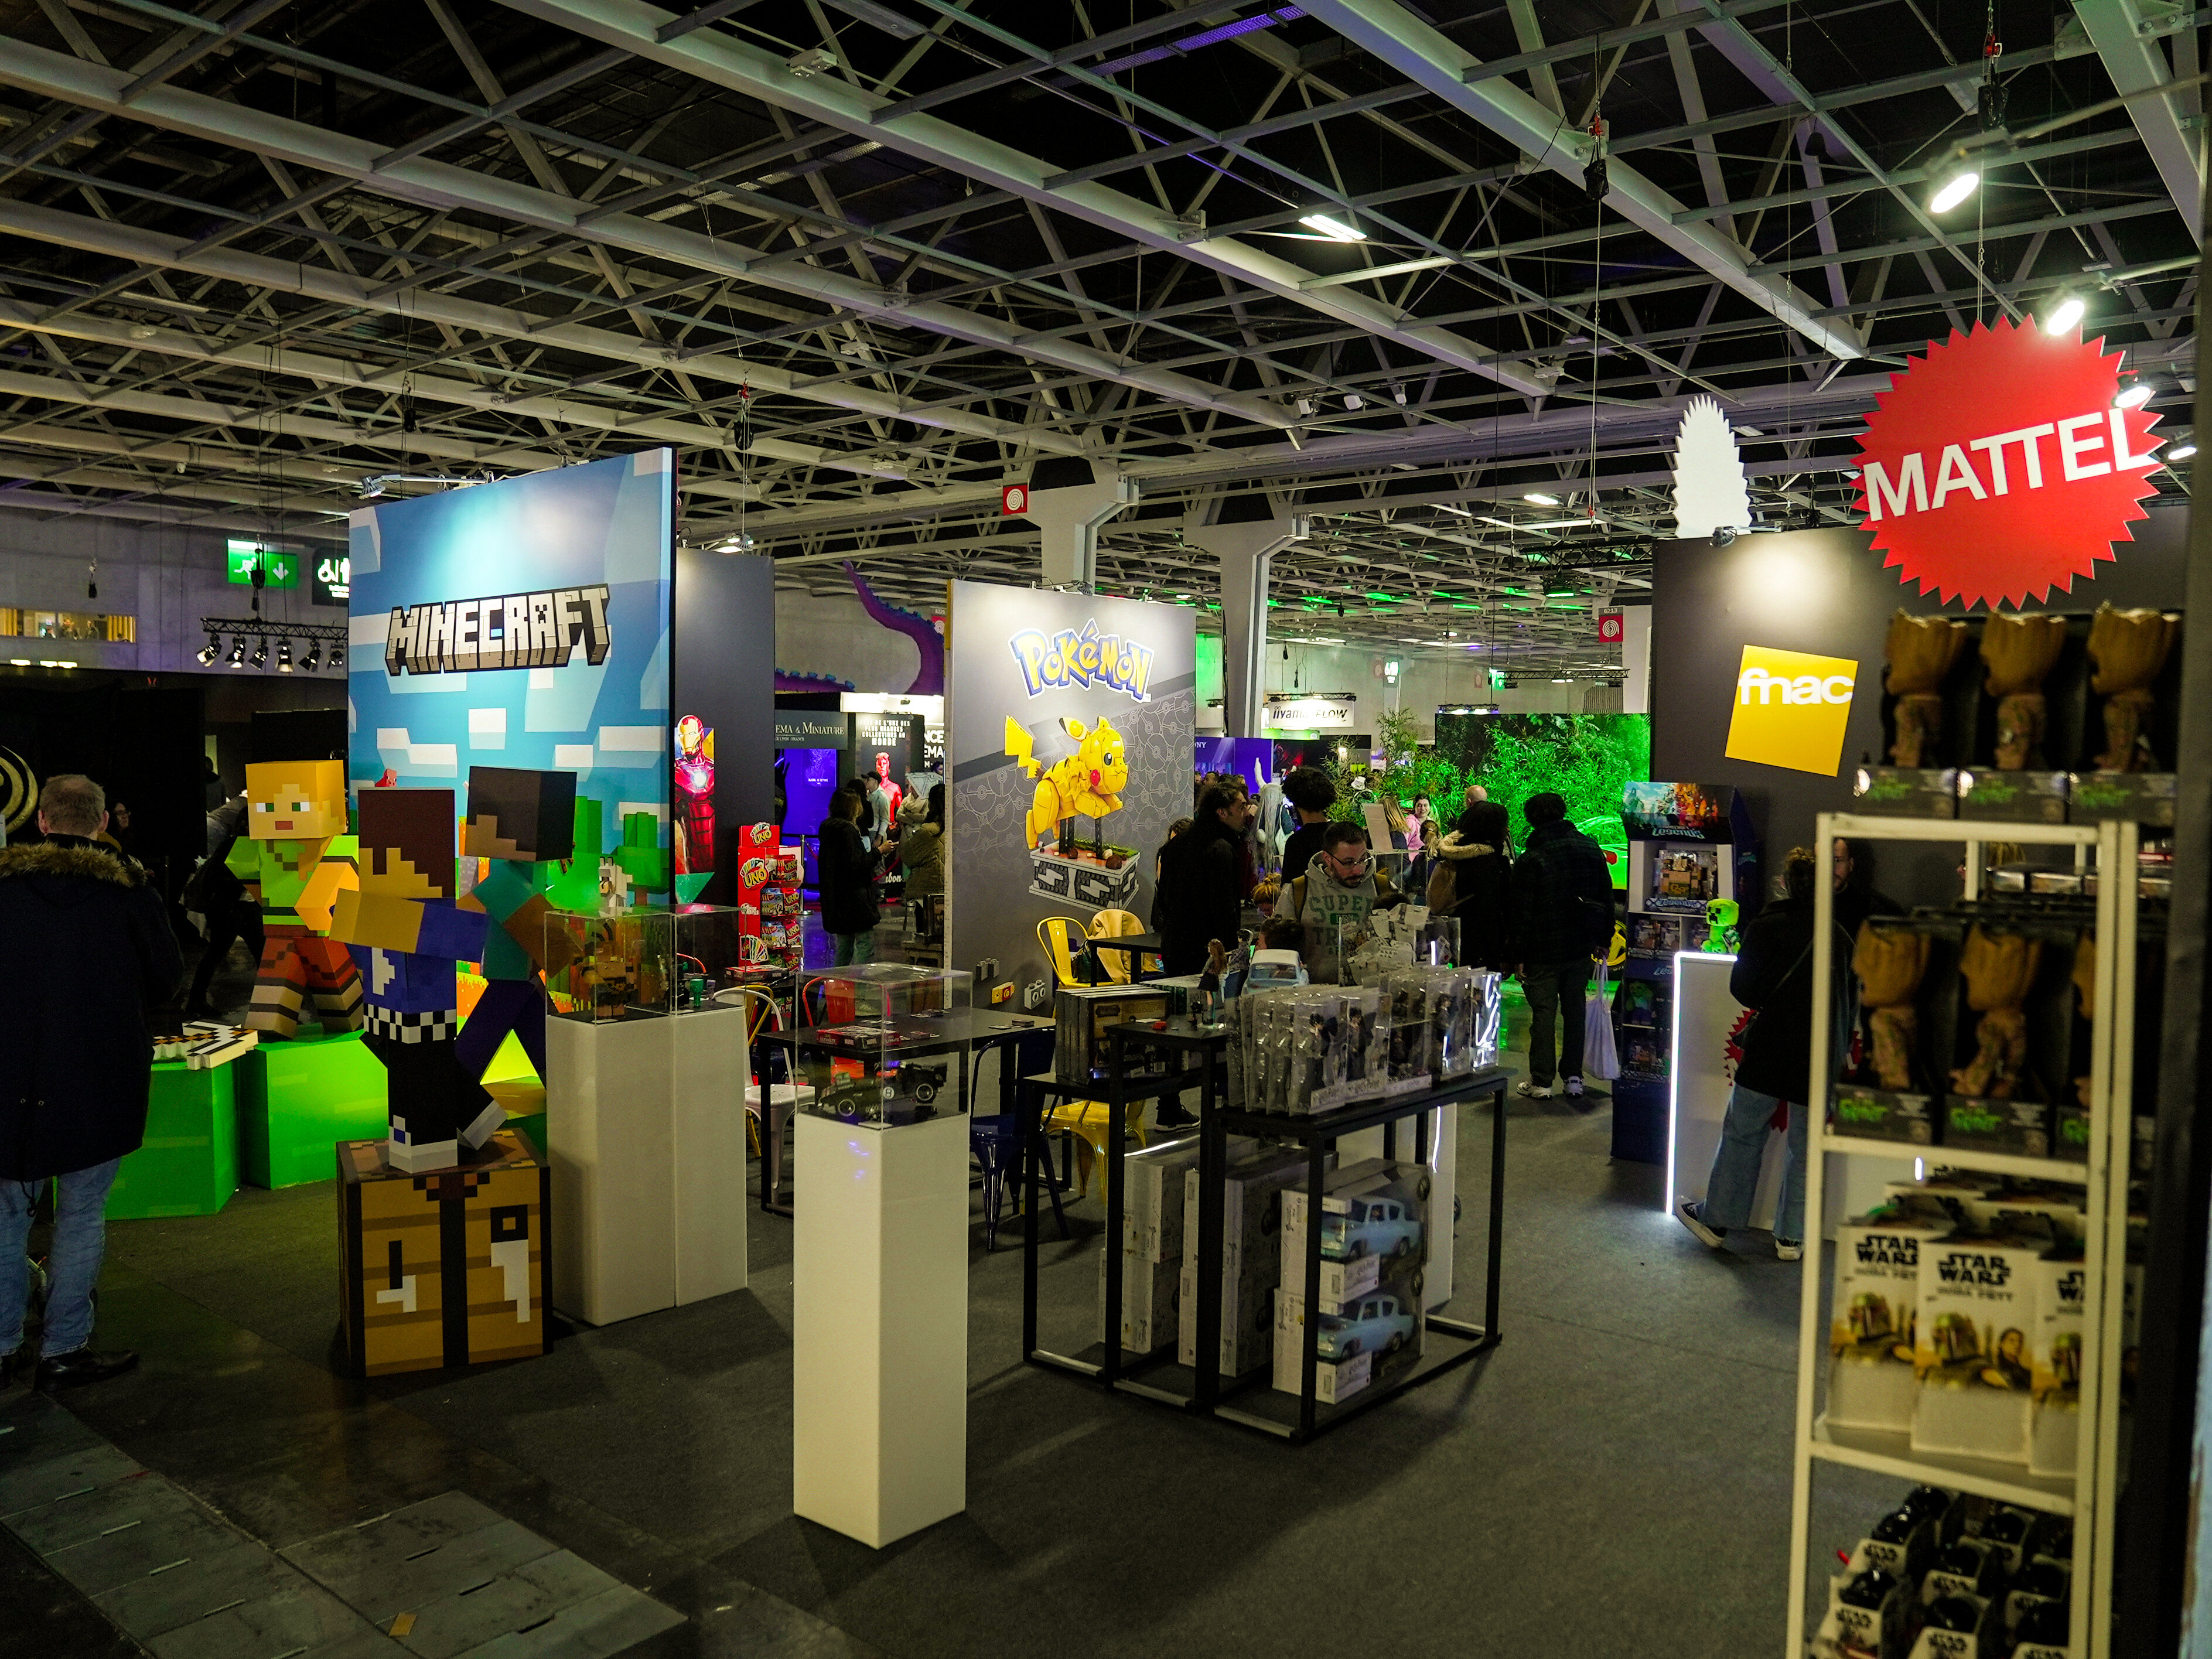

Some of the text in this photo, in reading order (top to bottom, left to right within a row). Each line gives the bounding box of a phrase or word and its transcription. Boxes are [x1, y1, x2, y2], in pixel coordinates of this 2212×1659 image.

[1863, 408, 2158, 522] MATTEL
[385, 583, 610, 676] MINECRAFT
[1738, 667, 1854, 705] fnac
[753, 831, 772, 845] UNO
[744, 868, 767, 887] UNO
[786, 892, 799, 904] UNO
[787, 924, 800, 937] UNO
[786, 957, 798, 968] UNO
[1858, 1235, 1918, 1250] STAR
[1857, 1250, 1917, 1265] WARS
[1939, 1252, 2006, 1272] STAR
[1939, 1267, 2010, 1286] WARS
